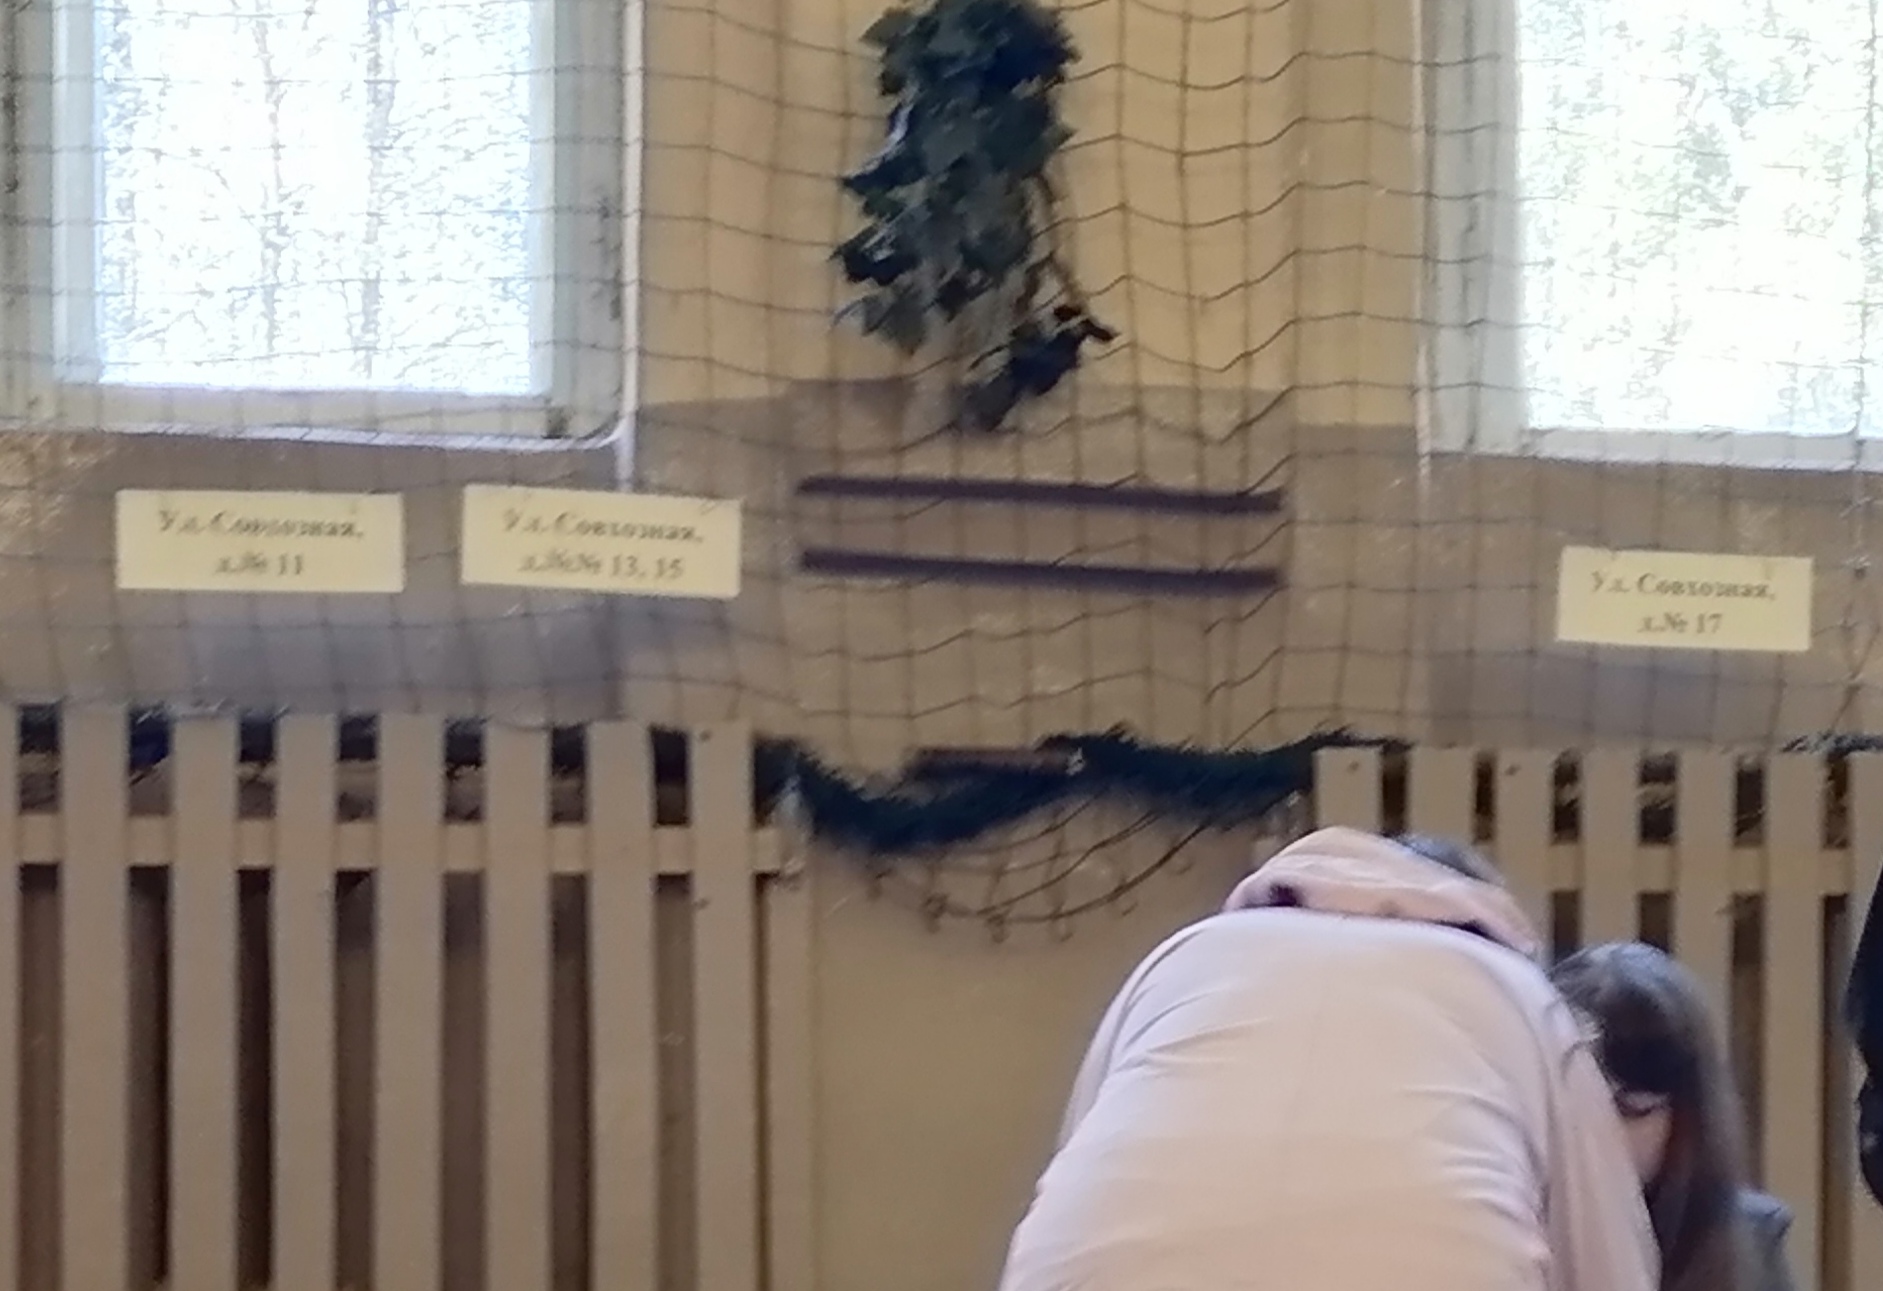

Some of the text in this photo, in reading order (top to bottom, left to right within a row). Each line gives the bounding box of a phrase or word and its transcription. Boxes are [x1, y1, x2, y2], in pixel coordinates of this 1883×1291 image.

[277, 552, 305, 576] 11
[653, 556, 685, 580] 15
[1695, 611, 1724, 634] 17
